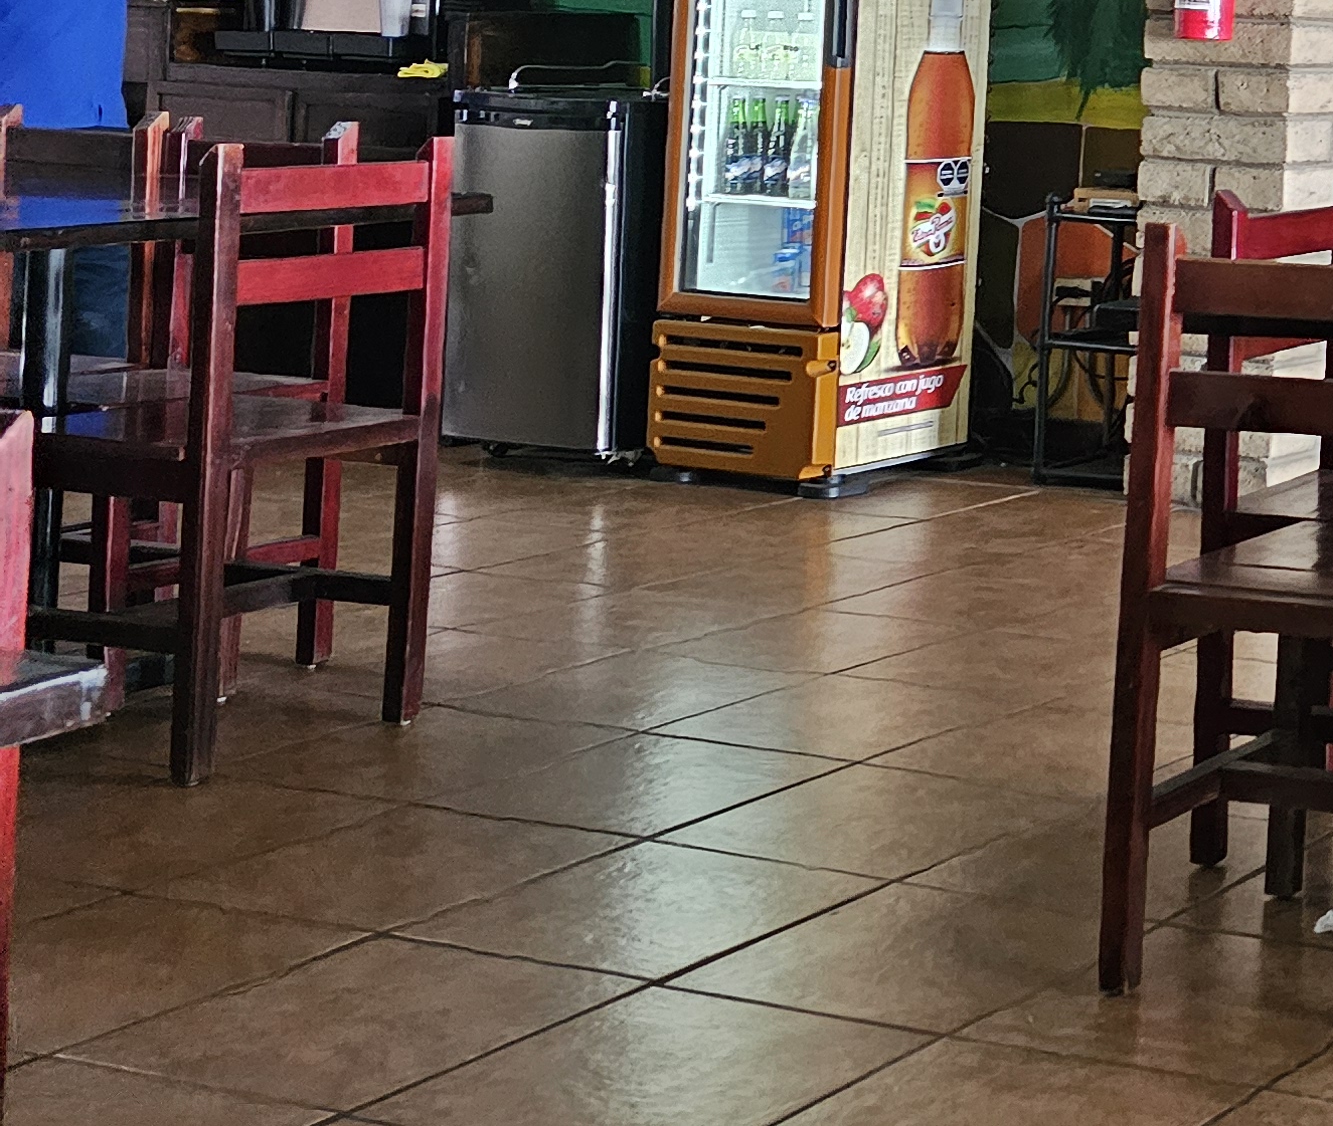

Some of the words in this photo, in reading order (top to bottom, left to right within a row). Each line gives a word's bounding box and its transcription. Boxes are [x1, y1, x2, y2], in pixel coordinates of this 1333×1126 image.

[845, 383, 894, 405] Refresco
[895, 379, 917, 394] con
[915, 374, 944, 395] jugo
[844, 405, 861, 422] de
[861, 397, 917, 419] manzana
